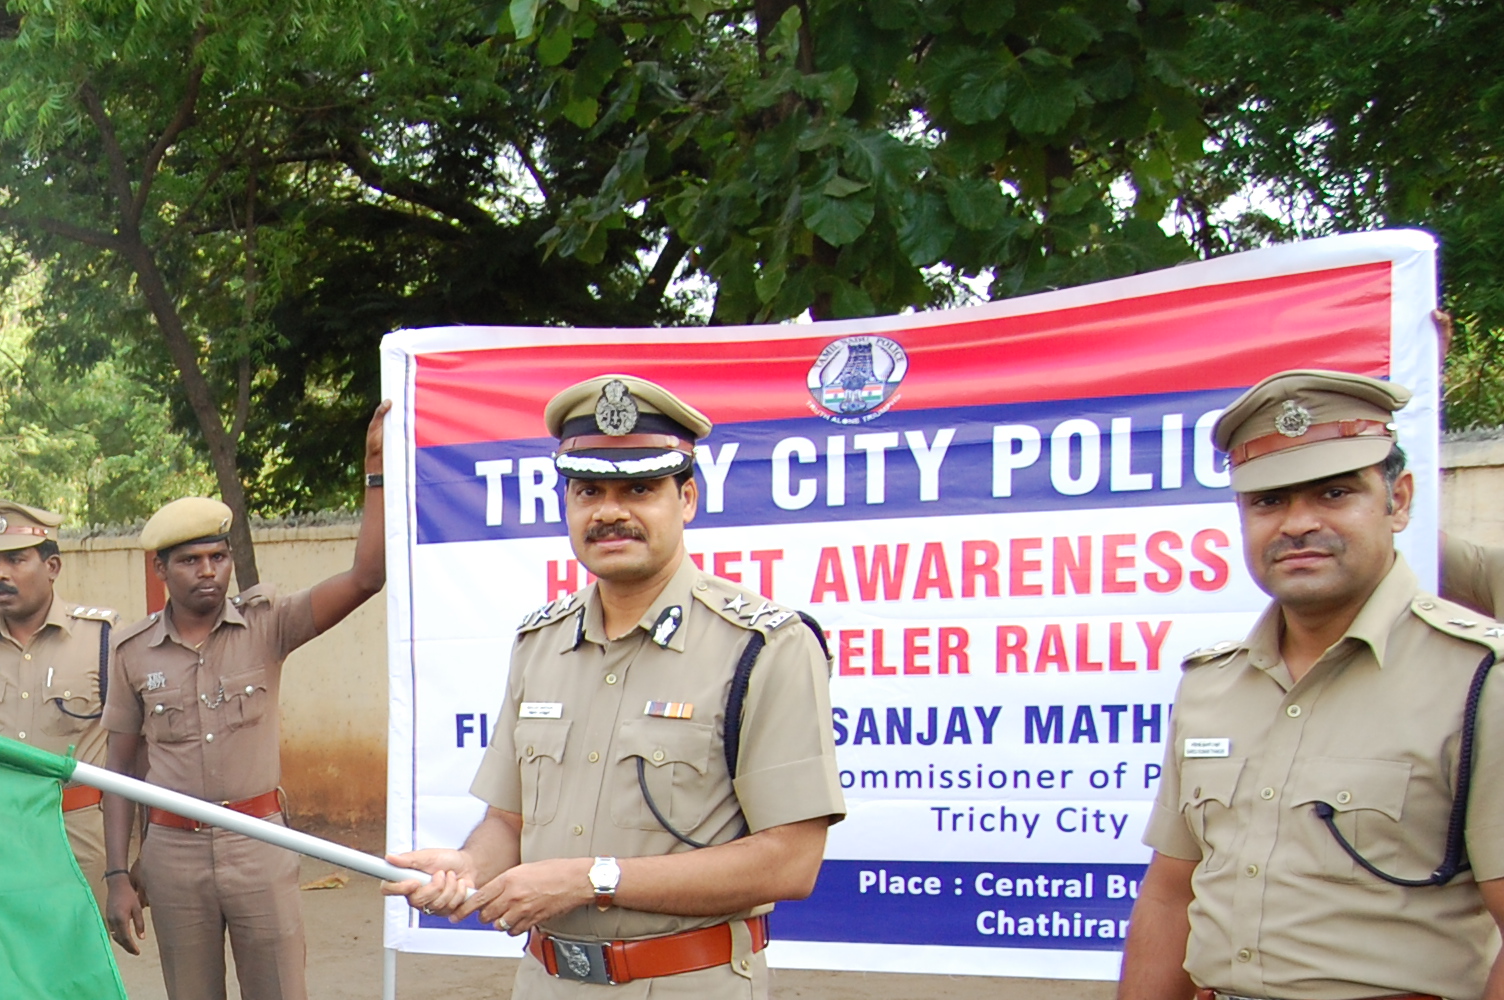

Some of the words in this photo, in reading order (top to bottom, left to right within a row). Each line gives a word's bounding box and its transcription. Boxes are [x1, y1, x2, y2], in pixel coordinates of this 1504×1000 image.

[816, 343, 840, 368] TAMIL
[876, 337, 904, 363] POLICE
[475, 442, 740, 526] TRY
[771, 428, 956, 511] CITY
[992, 407, 1234, 499] POLIC
[547, 548, 784, 604] HET
[809, 527, 1231, 604] AWARENESS
[823, 626, 971, 677] ELER
[995, 620, 1173, 674] RALLY
[832, 705, 1003, 746] SANJAY
[1024, 703, 1173, 745] MATH
[839, 763, 1074, 789] ommissioner
[1089, 761, 1128, 789] of
[930, 806, 1041, 839] Trichy
[1056, 806, 1129, 840] City
[859, 869, 942, 896] Place
[954, 877, 963, 896] :
[974, 872, 1094, 899] Central
[1107, 874, 1141, 899] Bu
